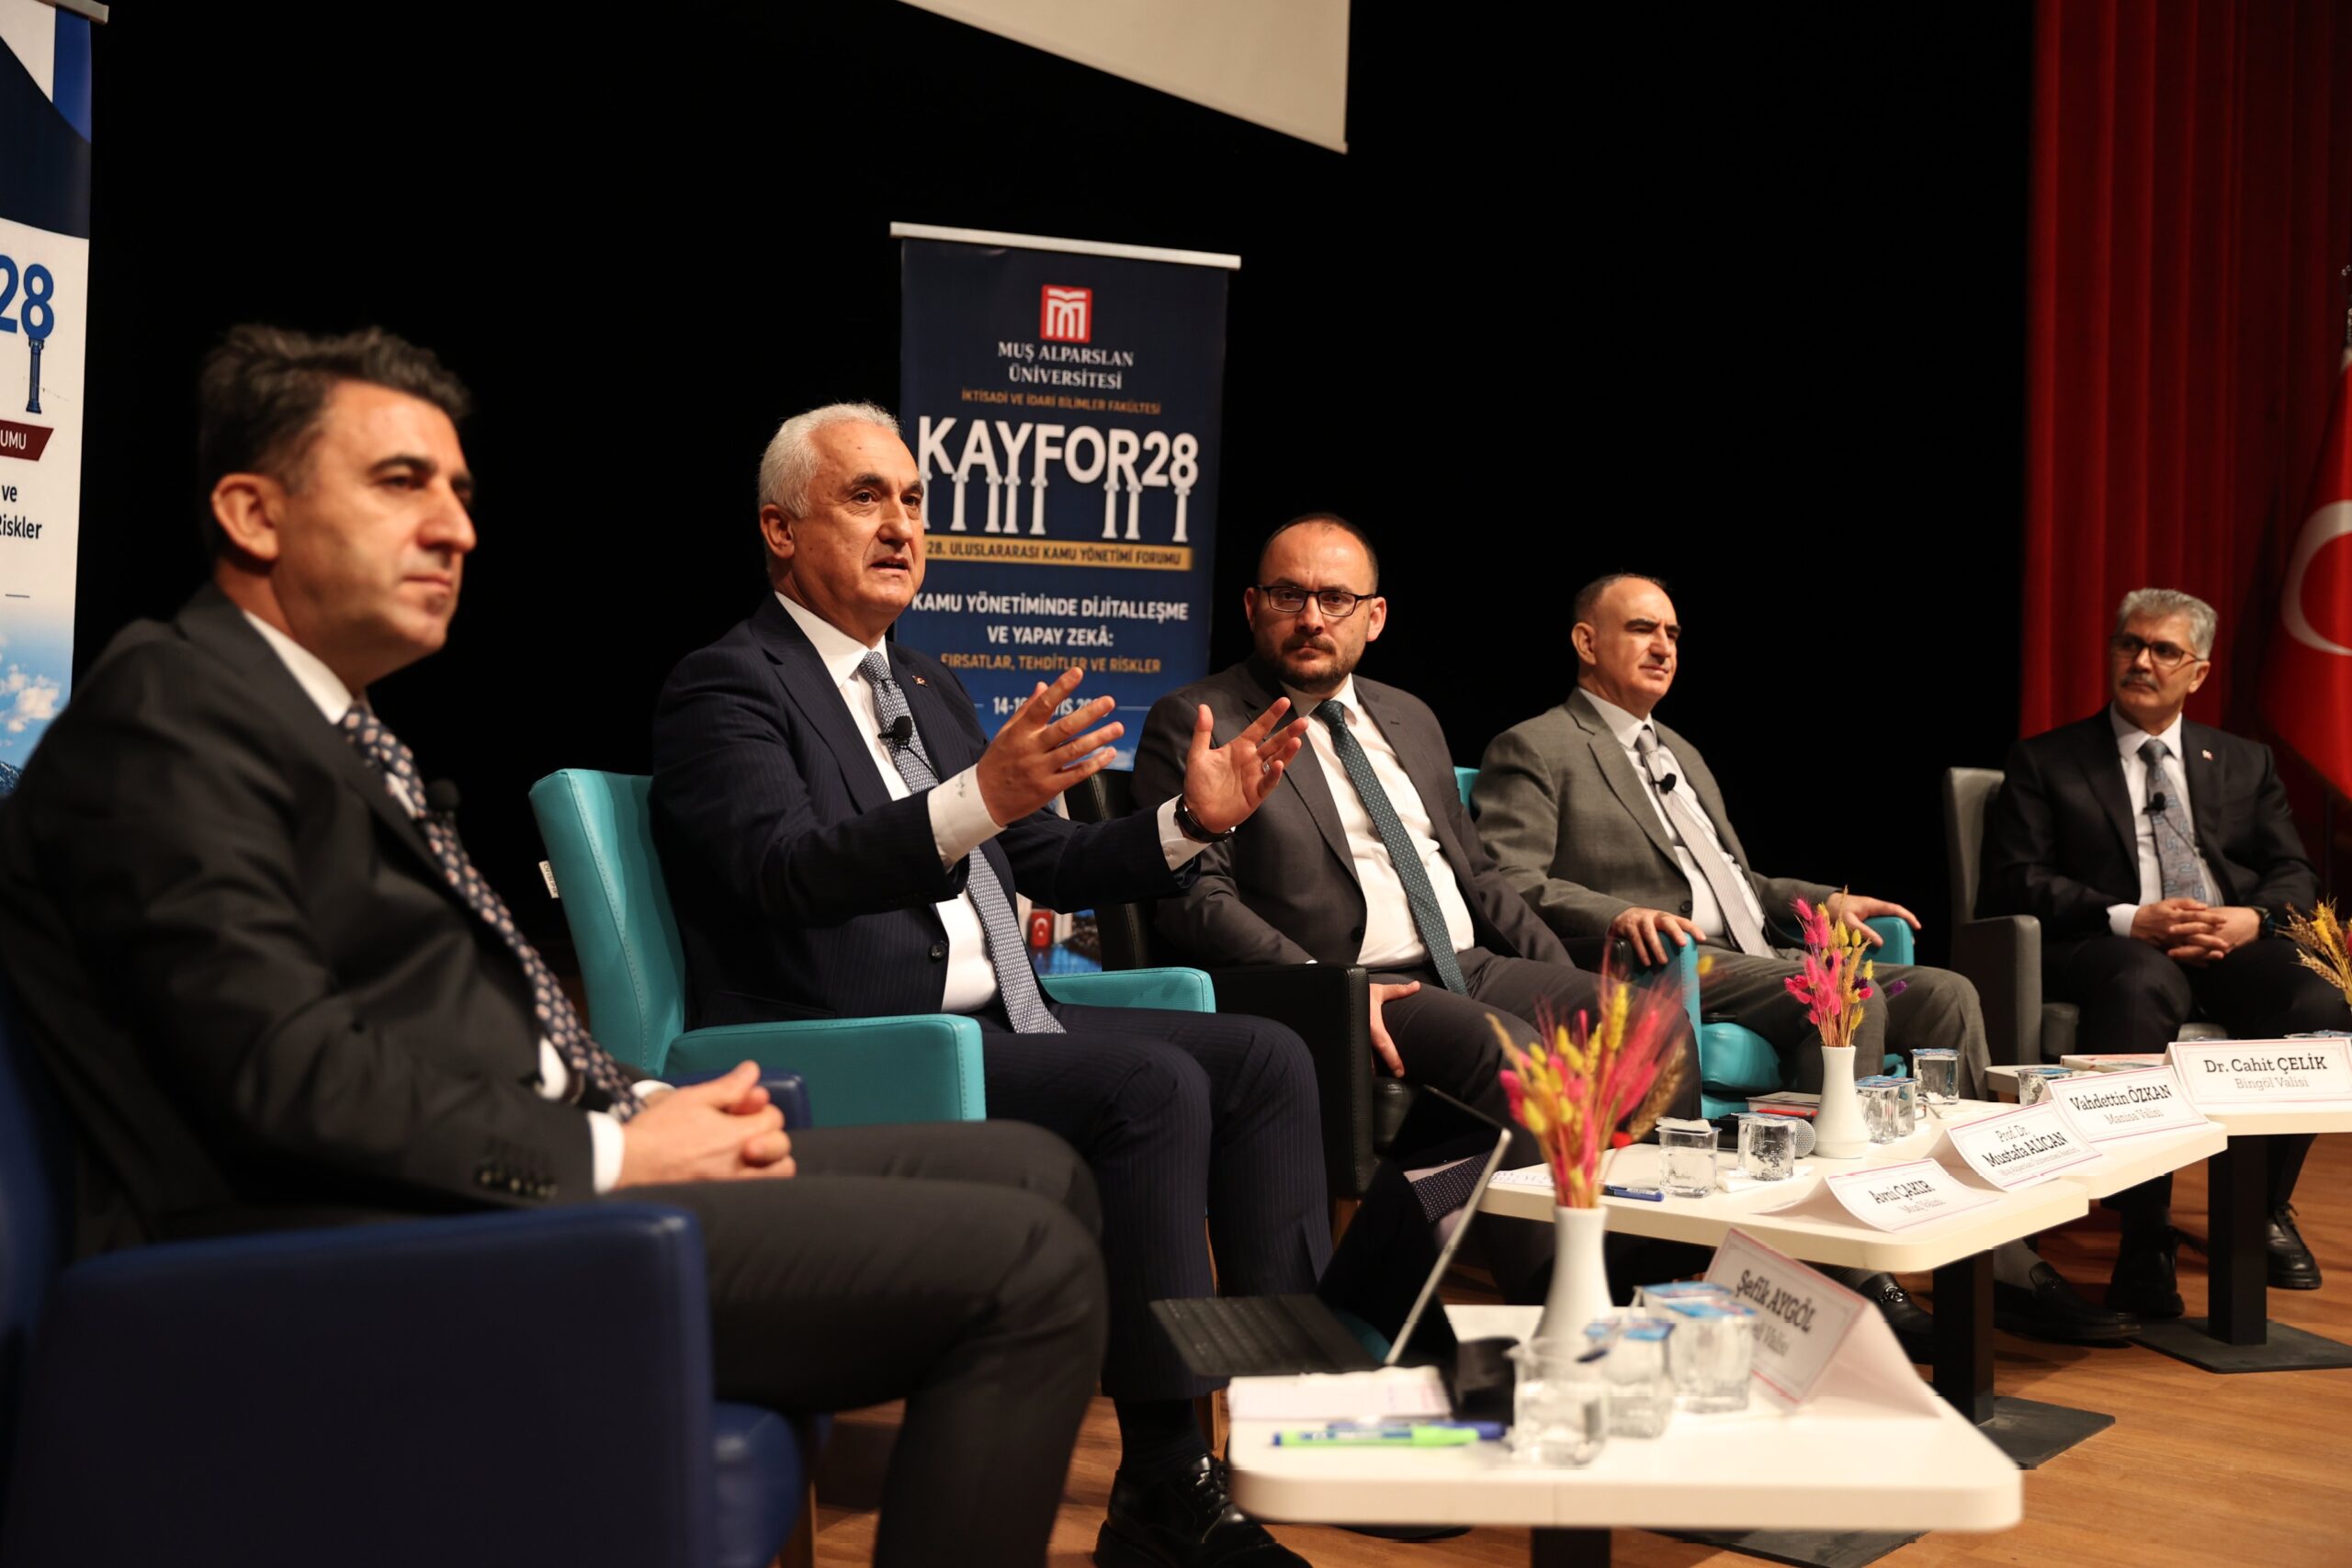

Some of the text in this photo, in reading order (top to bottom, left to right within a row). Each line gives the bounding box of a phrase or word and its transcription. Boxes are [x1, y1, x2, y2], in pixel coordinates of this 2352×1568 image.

[998, 341, 1134, 367] MUŞ ALPARSLAN
[1009, 363, 1122, 389] ÜNİVERSİTESİ
[961, 388, 1008, 404] İKTİSADİ
[1011, 393, 1023, 404] VE
[1108, 398, 1161, 414] FAKÜLTESİ
[919, 415, 1199, 488] KAYFOR28
[2, 485, 17, 502] ve
[950, 542, 1039, 558] ULUSLARARASI
[1043, 547, 1077, 561] KAMU
[1080, 547, 1132, 563] YÖNETİMİ
[1136, 551, 1182, 566] FORUMU
[912, 591, 1189, 624] KAMU YÖNETİMİNDE DİJİTALLEŞME
[988, 625, 1114, 647] VE YAPAY ZEKÂ:
[941, 653, 1161, 672] FIRSATLAR, TEHDİTLER VE RİSKLER
[2203, 1053, 2327, 1074] Dr. Cahit ÇELİK
[2234, 1076, 2309, 1091] Bingöl Valisi
[2069, 1085, 2172, 1111] Vahdettin ÖZKAN
[1982, 1144, 2030, 1167] Mustafa
[1894, 1180, 1936, 1201] ÇAKIR
[1736, 1269, 1770, 1305] Şefik
[1766, 1287, 1815, 1333] AYGÖL
